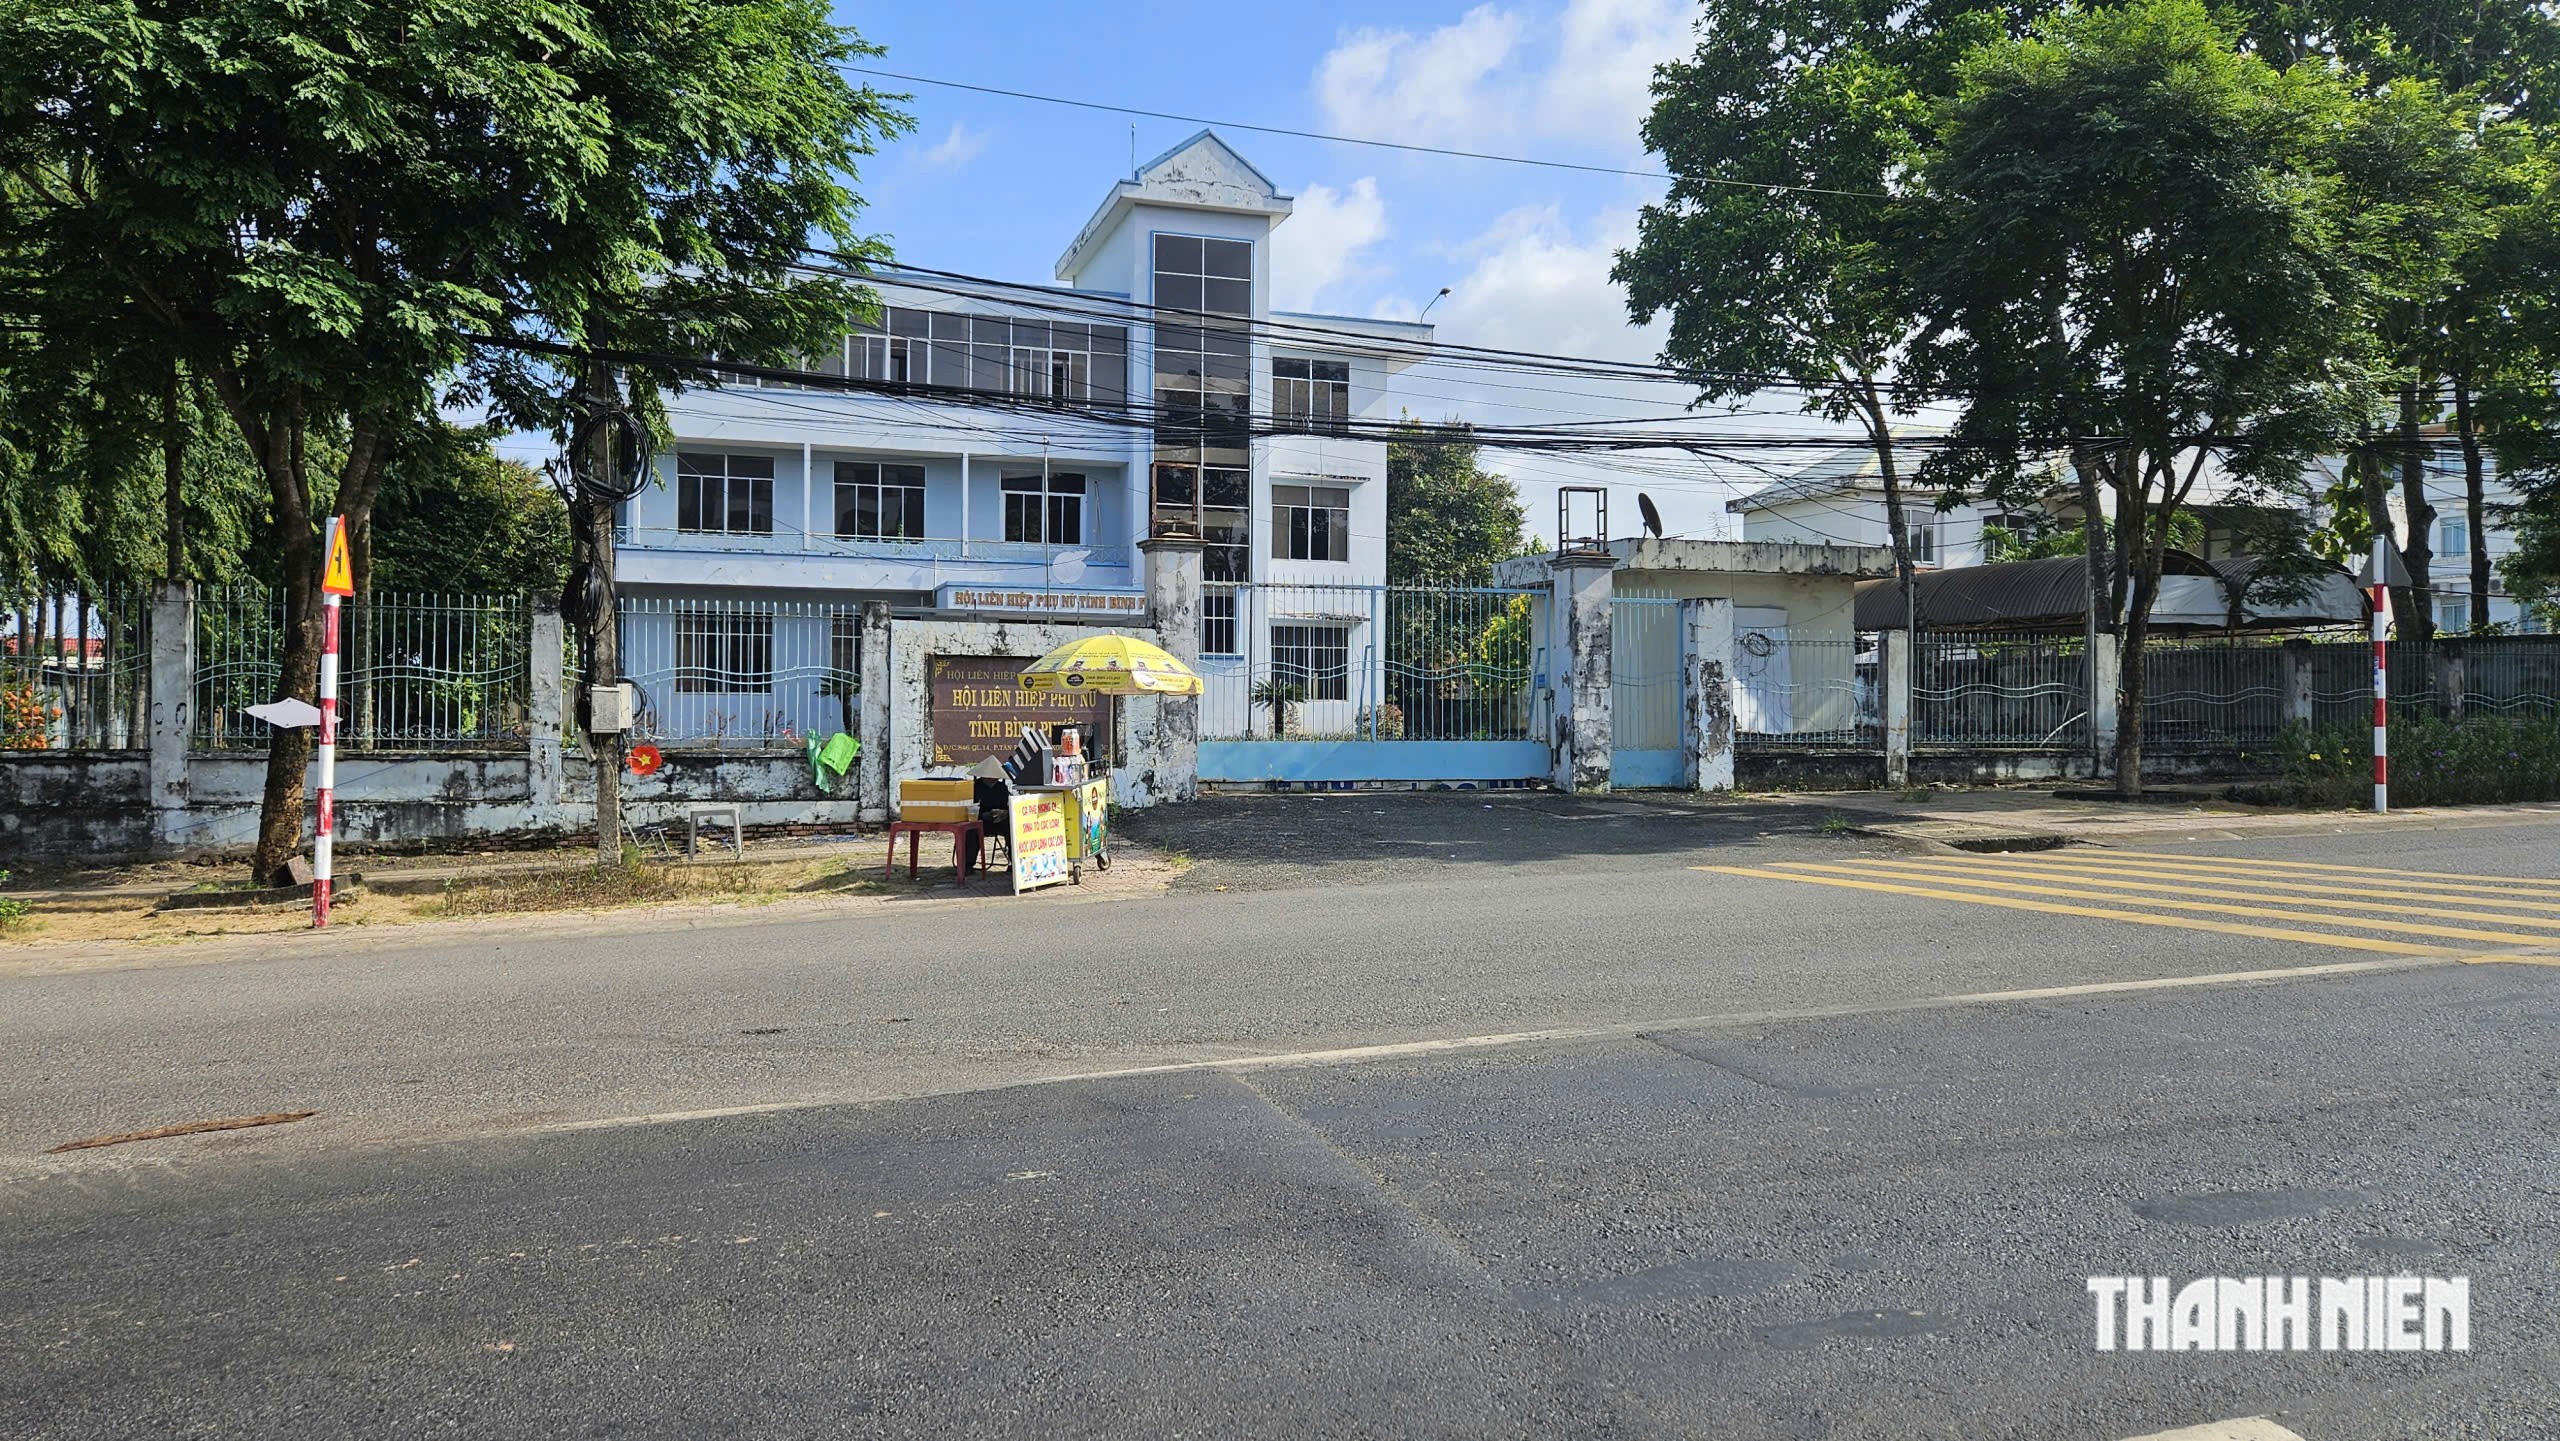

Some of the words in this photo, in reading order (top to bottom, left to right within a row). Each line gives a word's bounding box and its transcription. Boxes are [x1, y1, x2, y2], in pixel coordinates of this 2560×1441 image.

[955, 590, 976, 608] HỘI
[978, 591, 1004, 606] LIÊN
[1006, 592, 1033, 609] HIỆP
[1036, 594, 1059, 610] PHỤ
[1109, 594, 1136, 609] BÌNH
[947, 669, 964, 680] HỘI
[968, 669, 990, 680] LIÊN
[952, 685, 977, 711] HỘI
[981, 685, 1011, 708] LIÊN
[1050, 692, 1076, 711] PHỤ
[969, 714, 1001, 738] TỈNH
